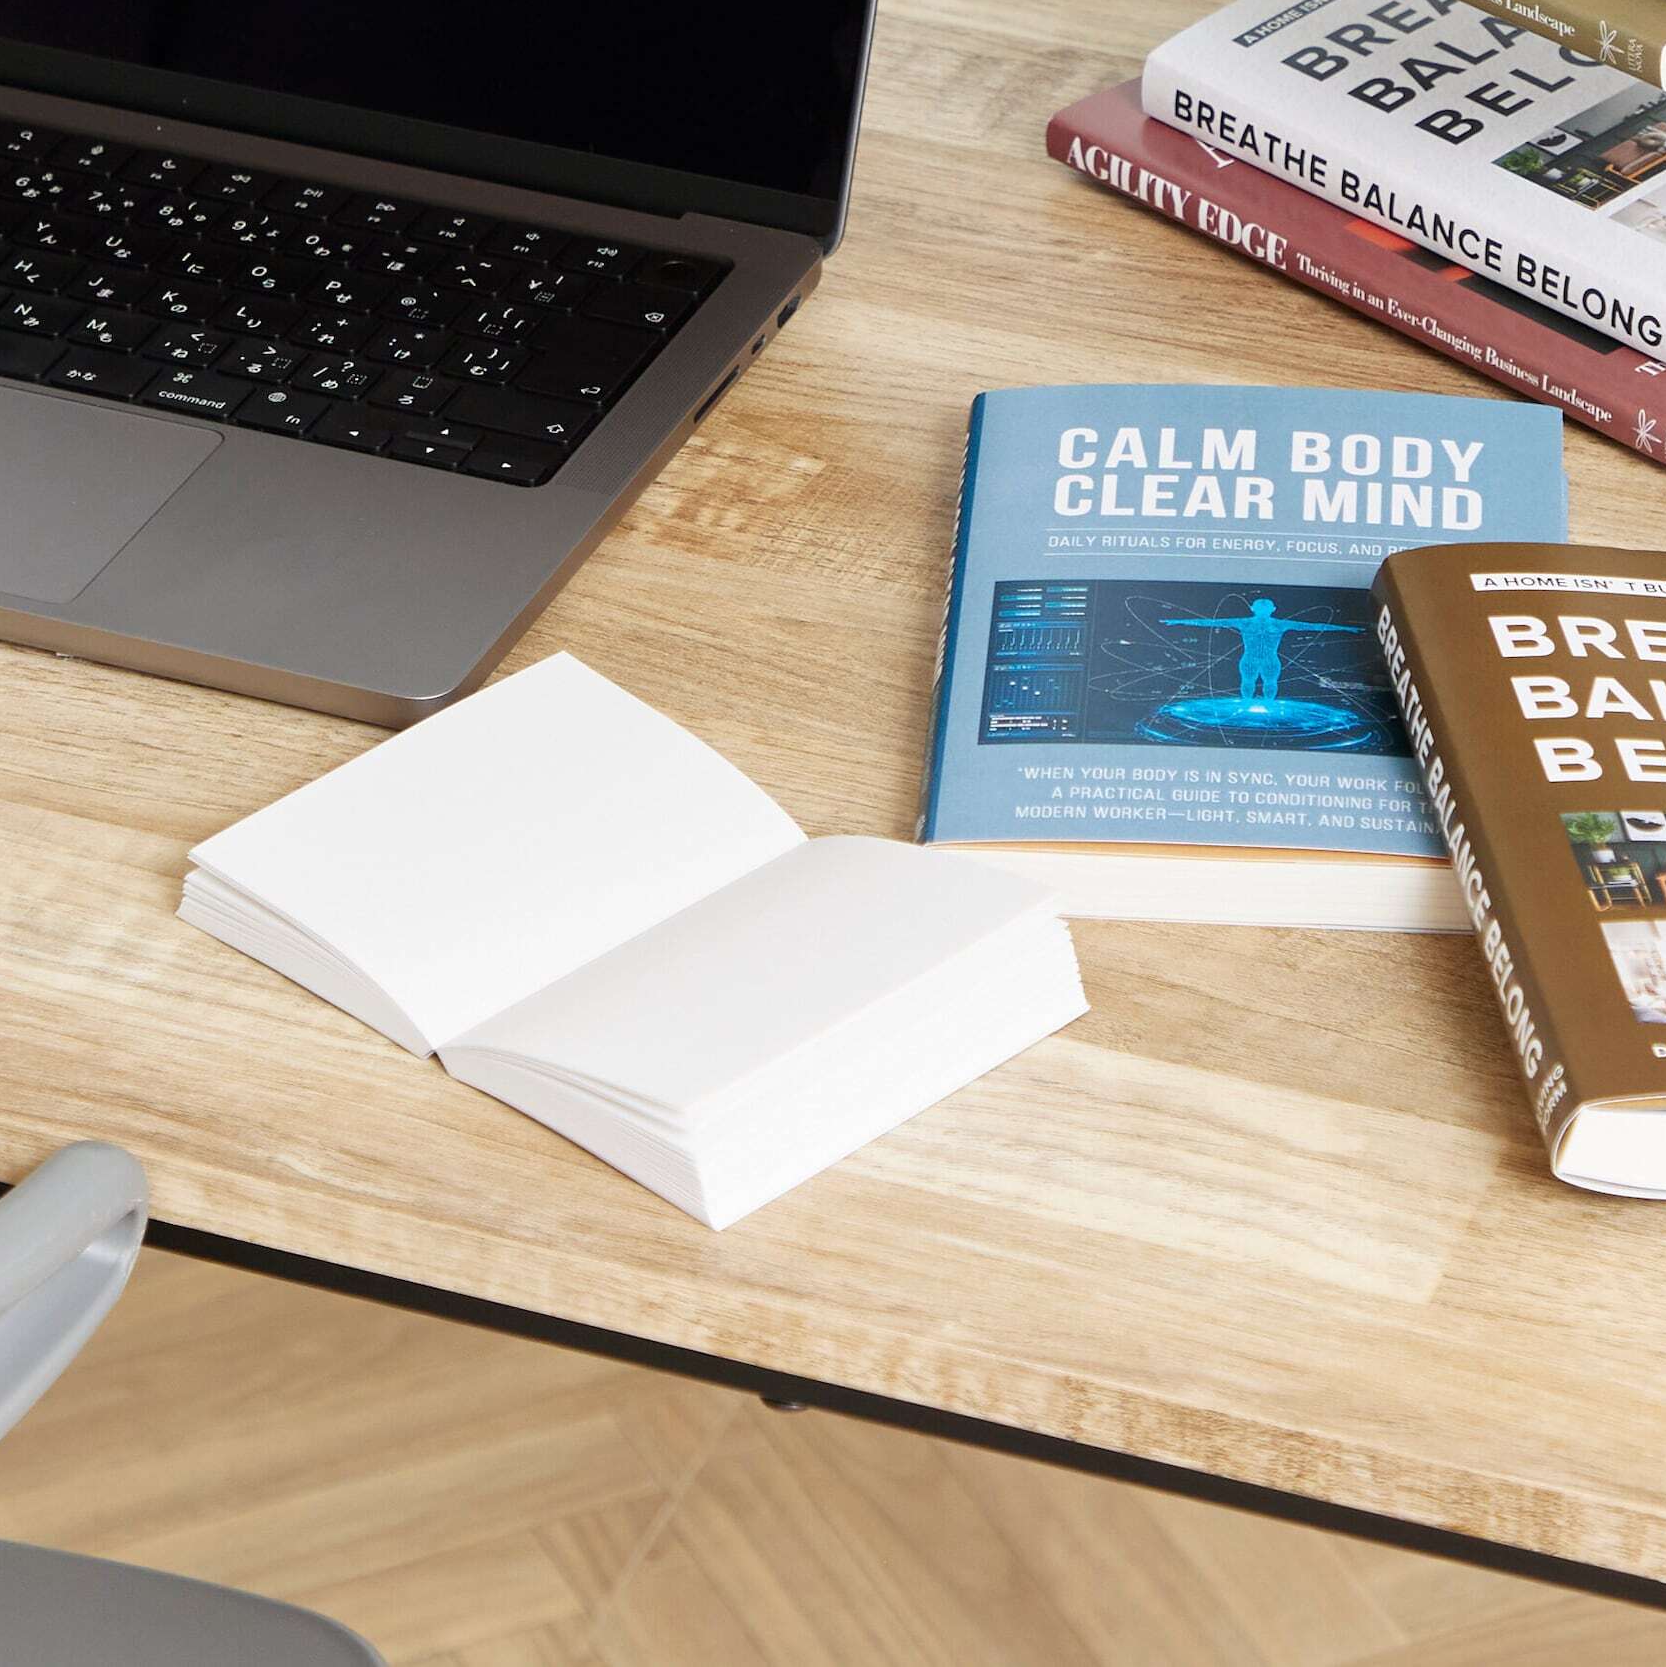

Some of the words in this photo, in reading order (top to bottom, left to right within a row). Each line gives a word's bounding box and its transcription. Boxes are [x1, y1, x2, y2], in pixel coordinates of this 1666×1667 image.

[1066, 136, 1193, 223] AGILITY
[1197, 197, 1289, 273] EDGE
[1174, 89, 1328, 188] BREATHE
[1341, 168, 1502, 272] BALANCE
[1516, 252, 1664, 350] BELONG
[158, 389, 226, 410] command
[285, 413, 301, 425] fn
[1057, 426, 1257, 472] CALM
[1290, 431, 1485, 483] BODY
[1053, 474, 1275, 521] CLEAR
[1303, 480, 1483, 531] MIND
[1048, 535, 1096, 549] DAILY
[1102, 536, 1170, 549] RITUALS
[1176, 537, 1206, 550] FOR
[1349, 542, 1382, 556] AND
[1377, 603, 1435, 770] BREATHE
[1427, 758, 1491, 932] BALANCE
[1483, 925, 1542, 1079] BELONG
